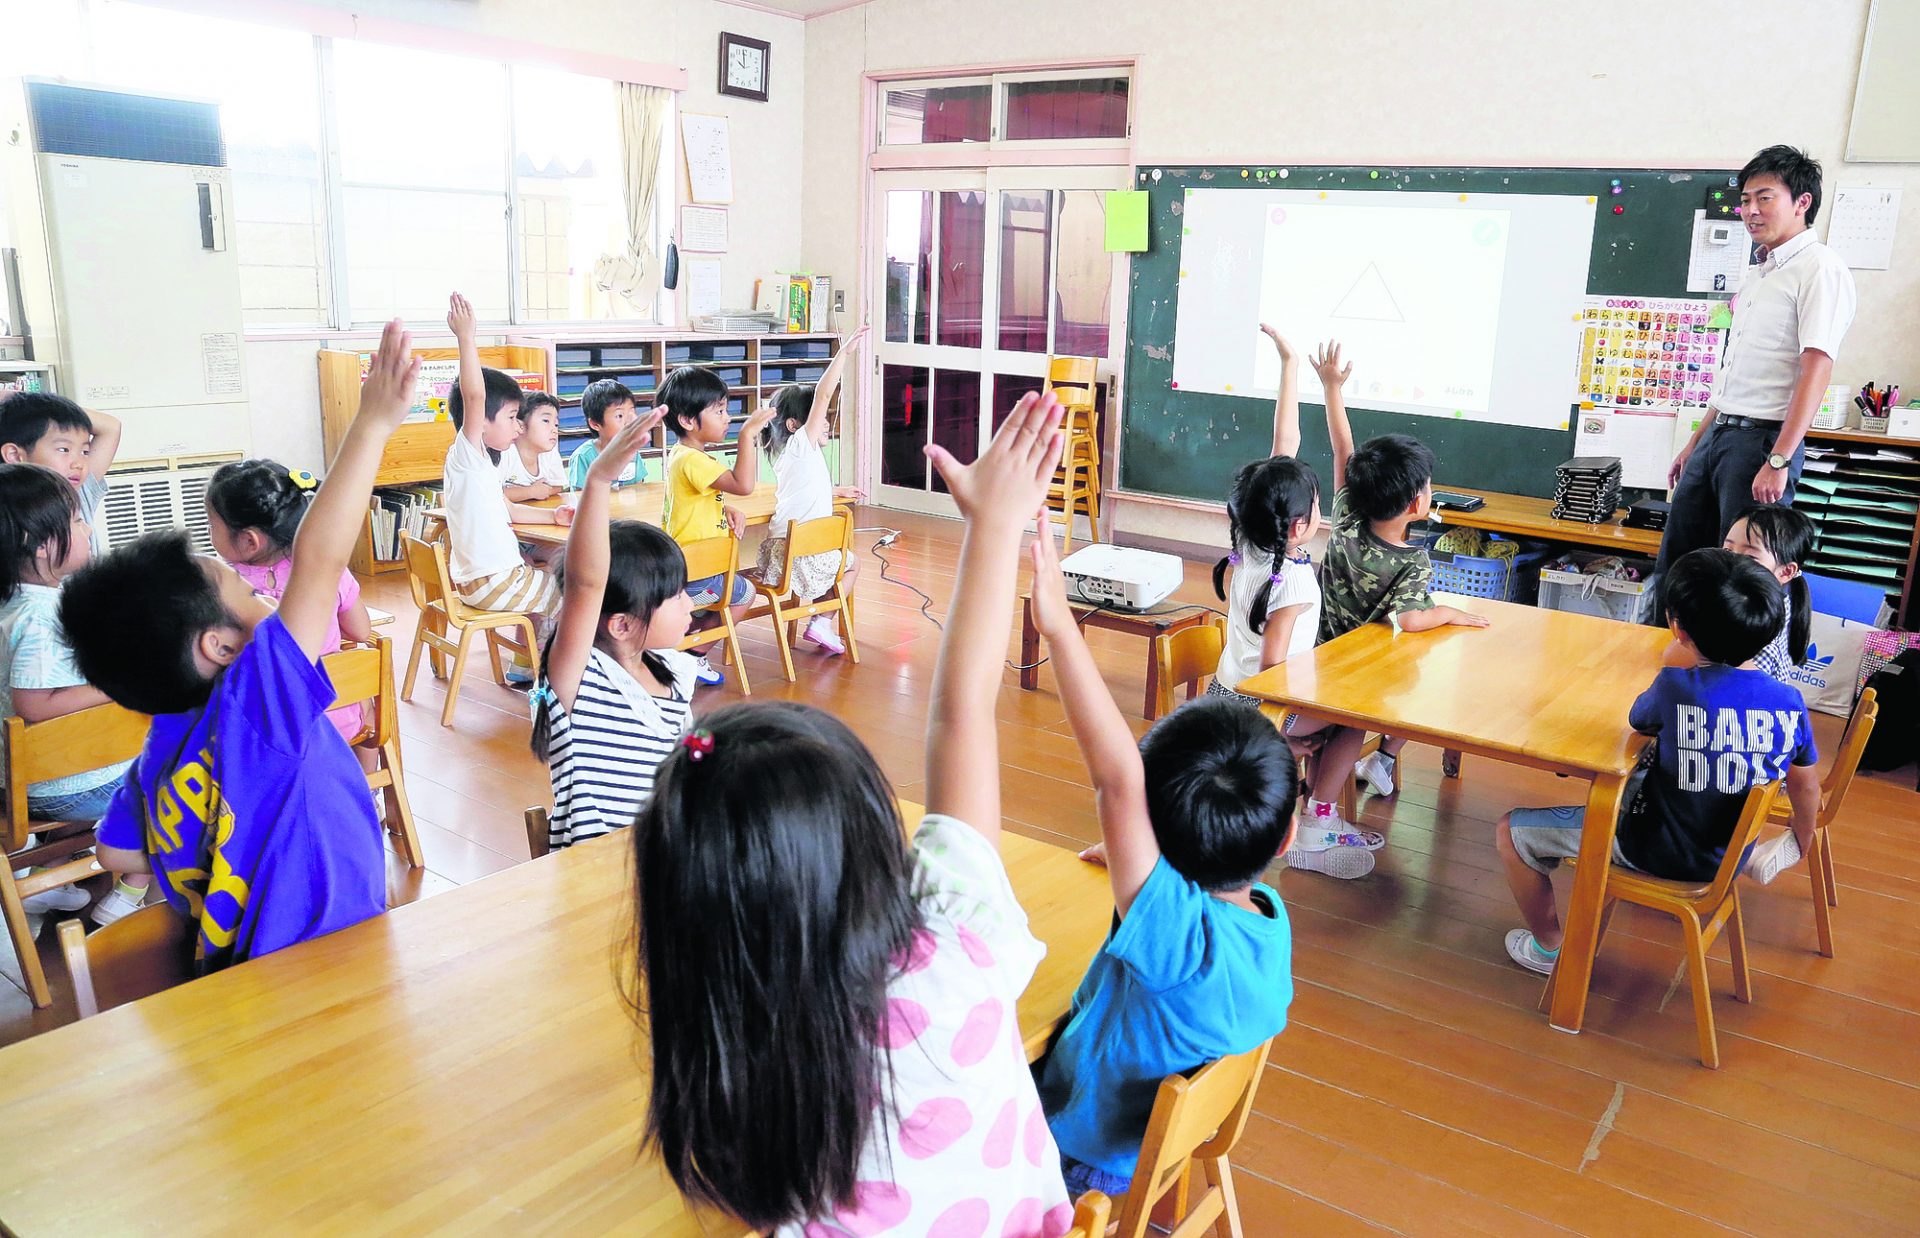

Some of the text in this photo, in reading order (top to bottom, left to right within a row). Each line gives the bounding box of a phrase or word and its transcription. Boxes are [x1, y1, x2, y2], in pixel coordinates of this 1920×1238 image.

[1838, 193, 1846, 203] 7
[1648, 301, 1708, 312] ひらがなひょう
[1790, 671, 1826, 688] didas
[1677, 704, 1802, 753] BABY
